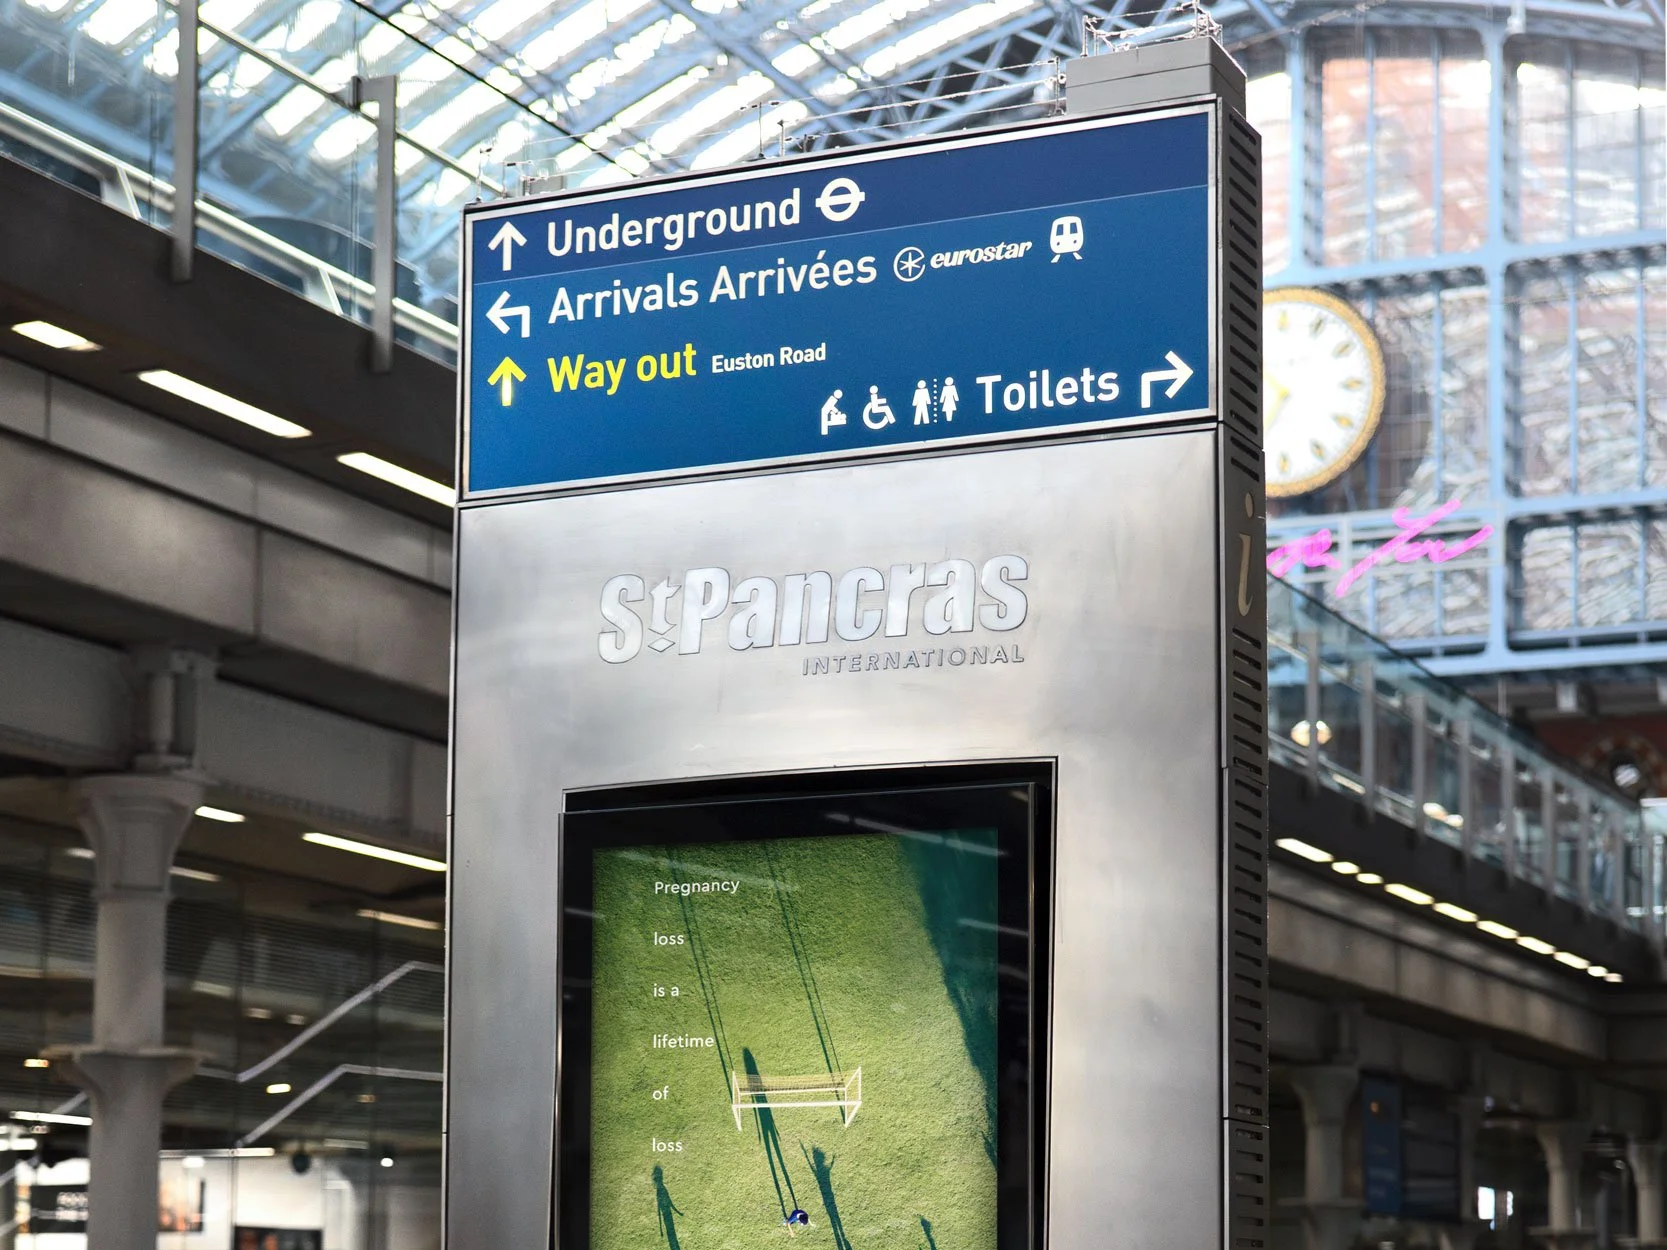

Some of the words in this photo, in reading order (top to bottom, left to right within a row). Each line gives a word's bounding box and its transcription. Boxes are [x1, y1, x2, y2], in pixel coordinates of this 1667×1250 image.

[548, 188, 802, 260] Underground
[548, 270, 699, 325] Arrivals
[709, 249, 877, 304] Arrivées
[930, 238, 1032, 270] eurostar
[548, 353, 626, 396] Way
[636, 342, 697, 382] out
[712, 349, 775, 374] Euston
[779, 343, 826, 367] Road
[976, 367, 1120, 415] Toilets
[801, 645, 1025, 676] INTERNATIONAL
[655, 878, 740, 896] Pregnancy
[653, 932, 685, 945] loss
[653, 983, 665, 997] is
[671, 986, 680, 997] a
[653, 1034, 714, 1049] lifetime
[652, 1086, 669, 1100] of
[652, 1138, 683, 1152] loss
